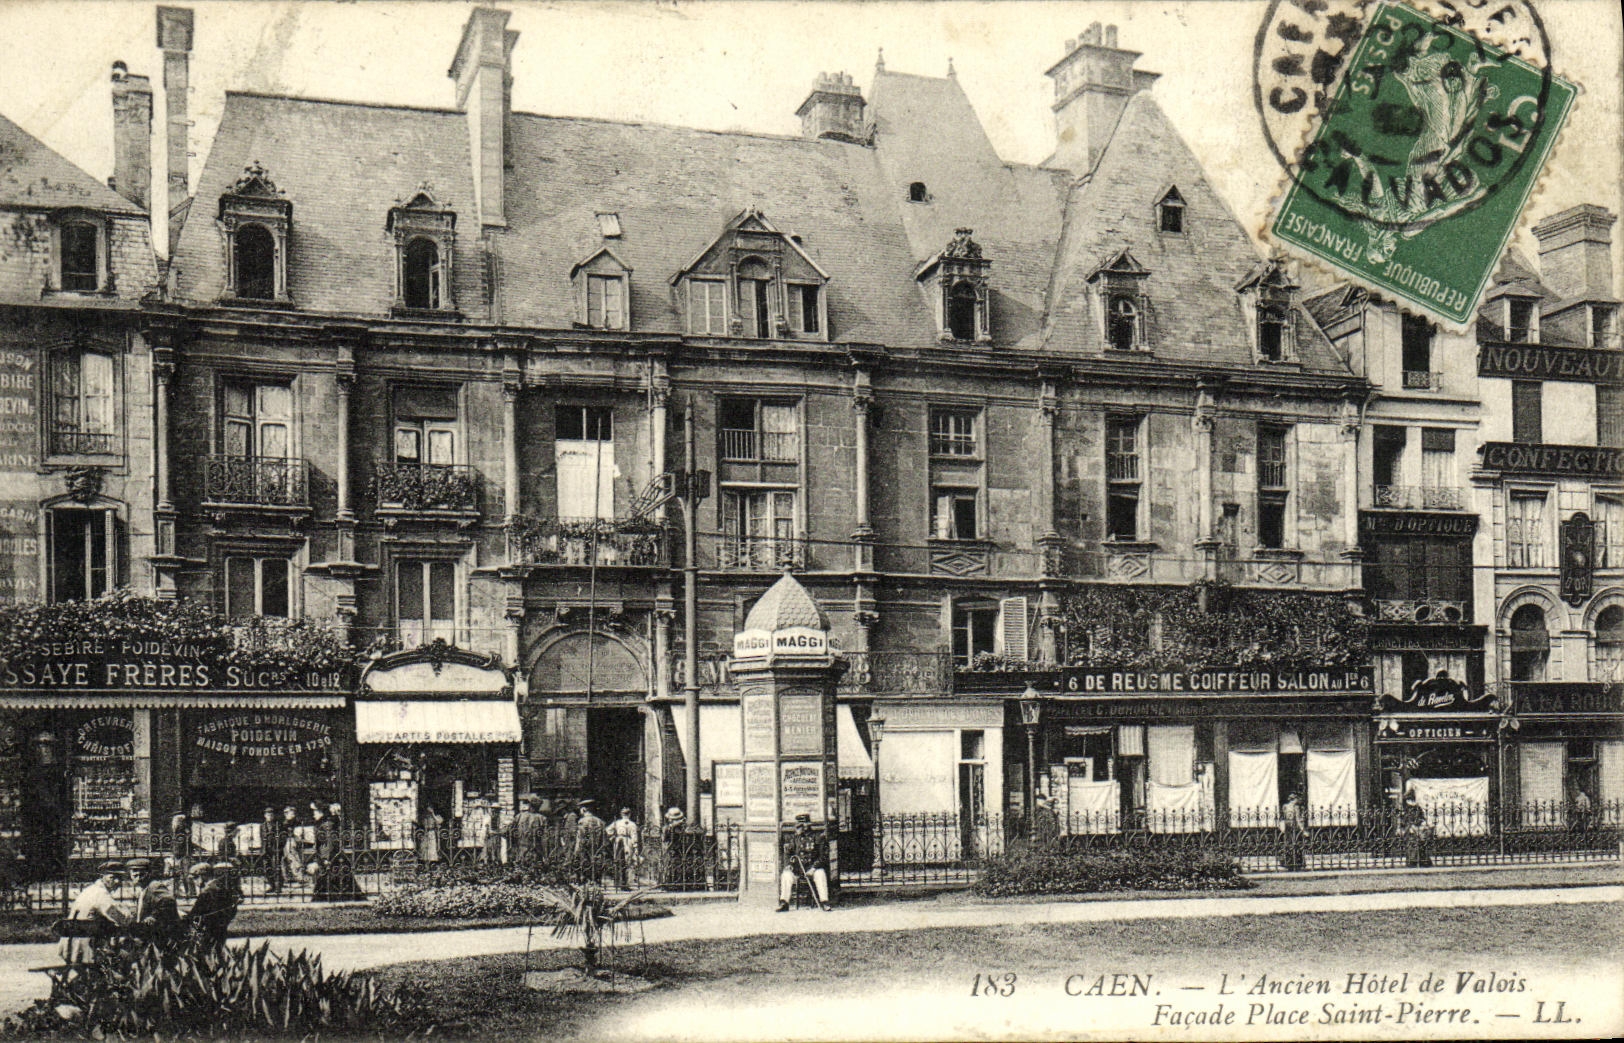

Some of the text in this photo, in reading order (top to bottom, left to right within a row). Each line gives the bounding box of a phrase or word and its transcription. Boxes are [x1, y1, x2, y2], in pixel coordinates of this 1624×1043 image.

[1284, 212, 1468, 312] REPUBLIQUE FRANÇAISE
[736, 637, 769, 649] MAGGI
[776, 635, 823, 648] MAGGI
[1068, 676, 1079, 691] 6
[1085, 675, 1106, 691] DE
[1111, 673, 1184, 691] REUSME
[1190, 673, 1271, 690] COIFFEUR
[1277, 672, 1329, 690] SALON
[231, 729, 297, 742] POIDEVIN
[386, 731, 493, 741] CARTES POSTALES
[1408, 728, 1462, 738] OPTICIEN
